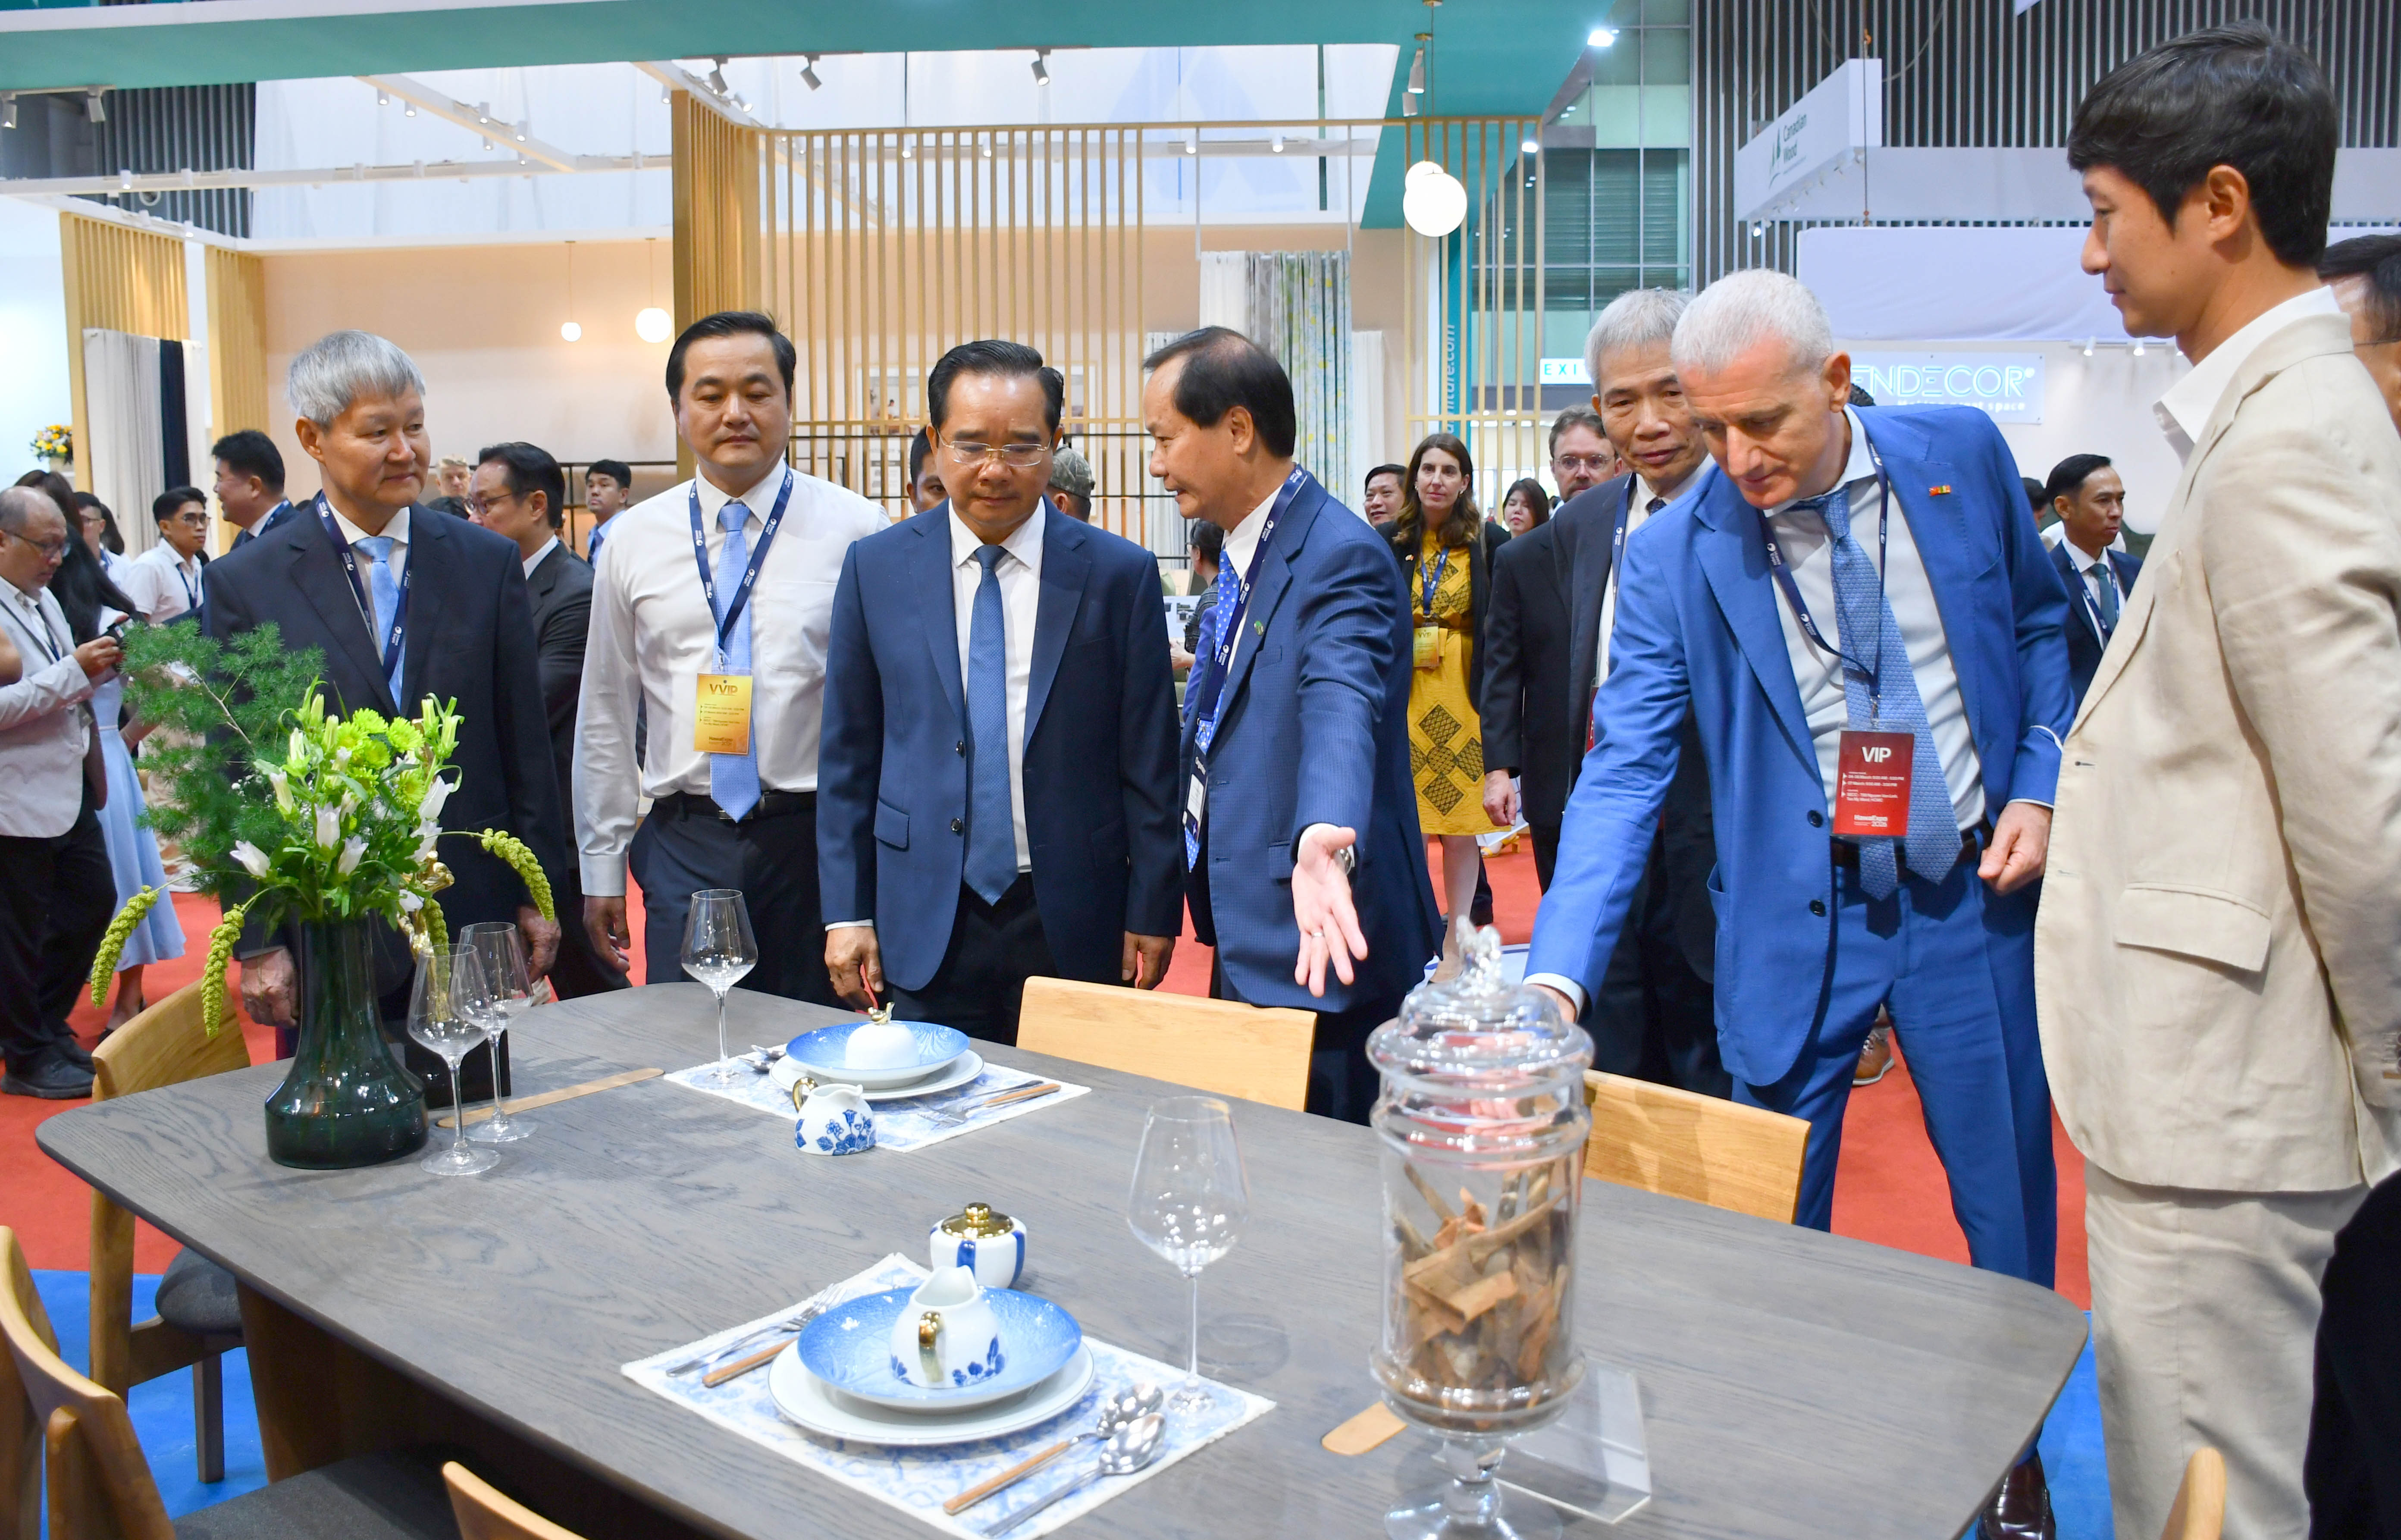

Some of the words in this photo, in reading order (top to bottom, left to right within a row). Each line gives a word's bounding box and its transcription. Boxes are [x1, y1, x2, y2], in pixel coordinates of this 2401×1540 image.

[1544, 364, 1577, 375] EXI
[1850, 365, 2025, 398] ENDECOR
[1987, 402, 2025, 413] space
[709, 684, 738, 695] VVIP
[1862, 746, 1891, 762] VIP
